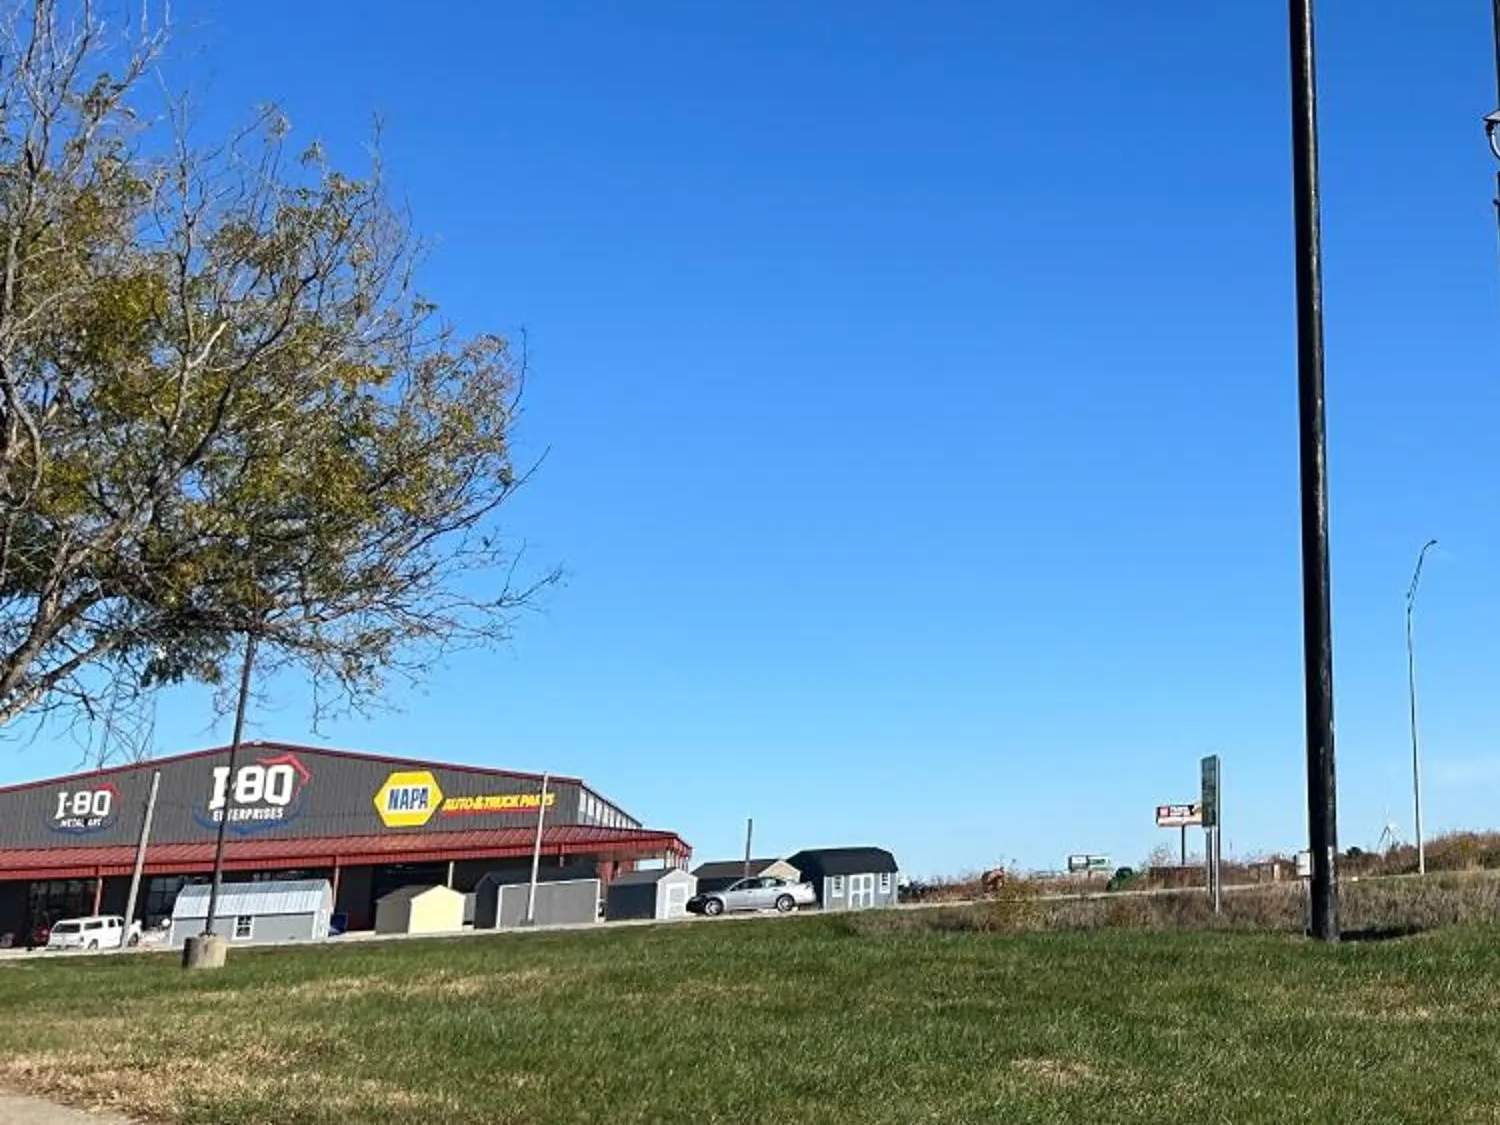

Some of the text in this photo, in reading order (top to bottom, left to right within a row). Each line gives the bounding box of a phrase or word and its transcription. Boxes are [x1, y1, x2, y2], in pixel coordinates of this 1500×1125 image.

[208, 765, 294, 809] I-80
[388, 787, 429, 811] NAPA
[54, 790, 112, 820] I-80
[442, 797, 474, 811] AUTO
[519, 792, 555, 808] PARS
